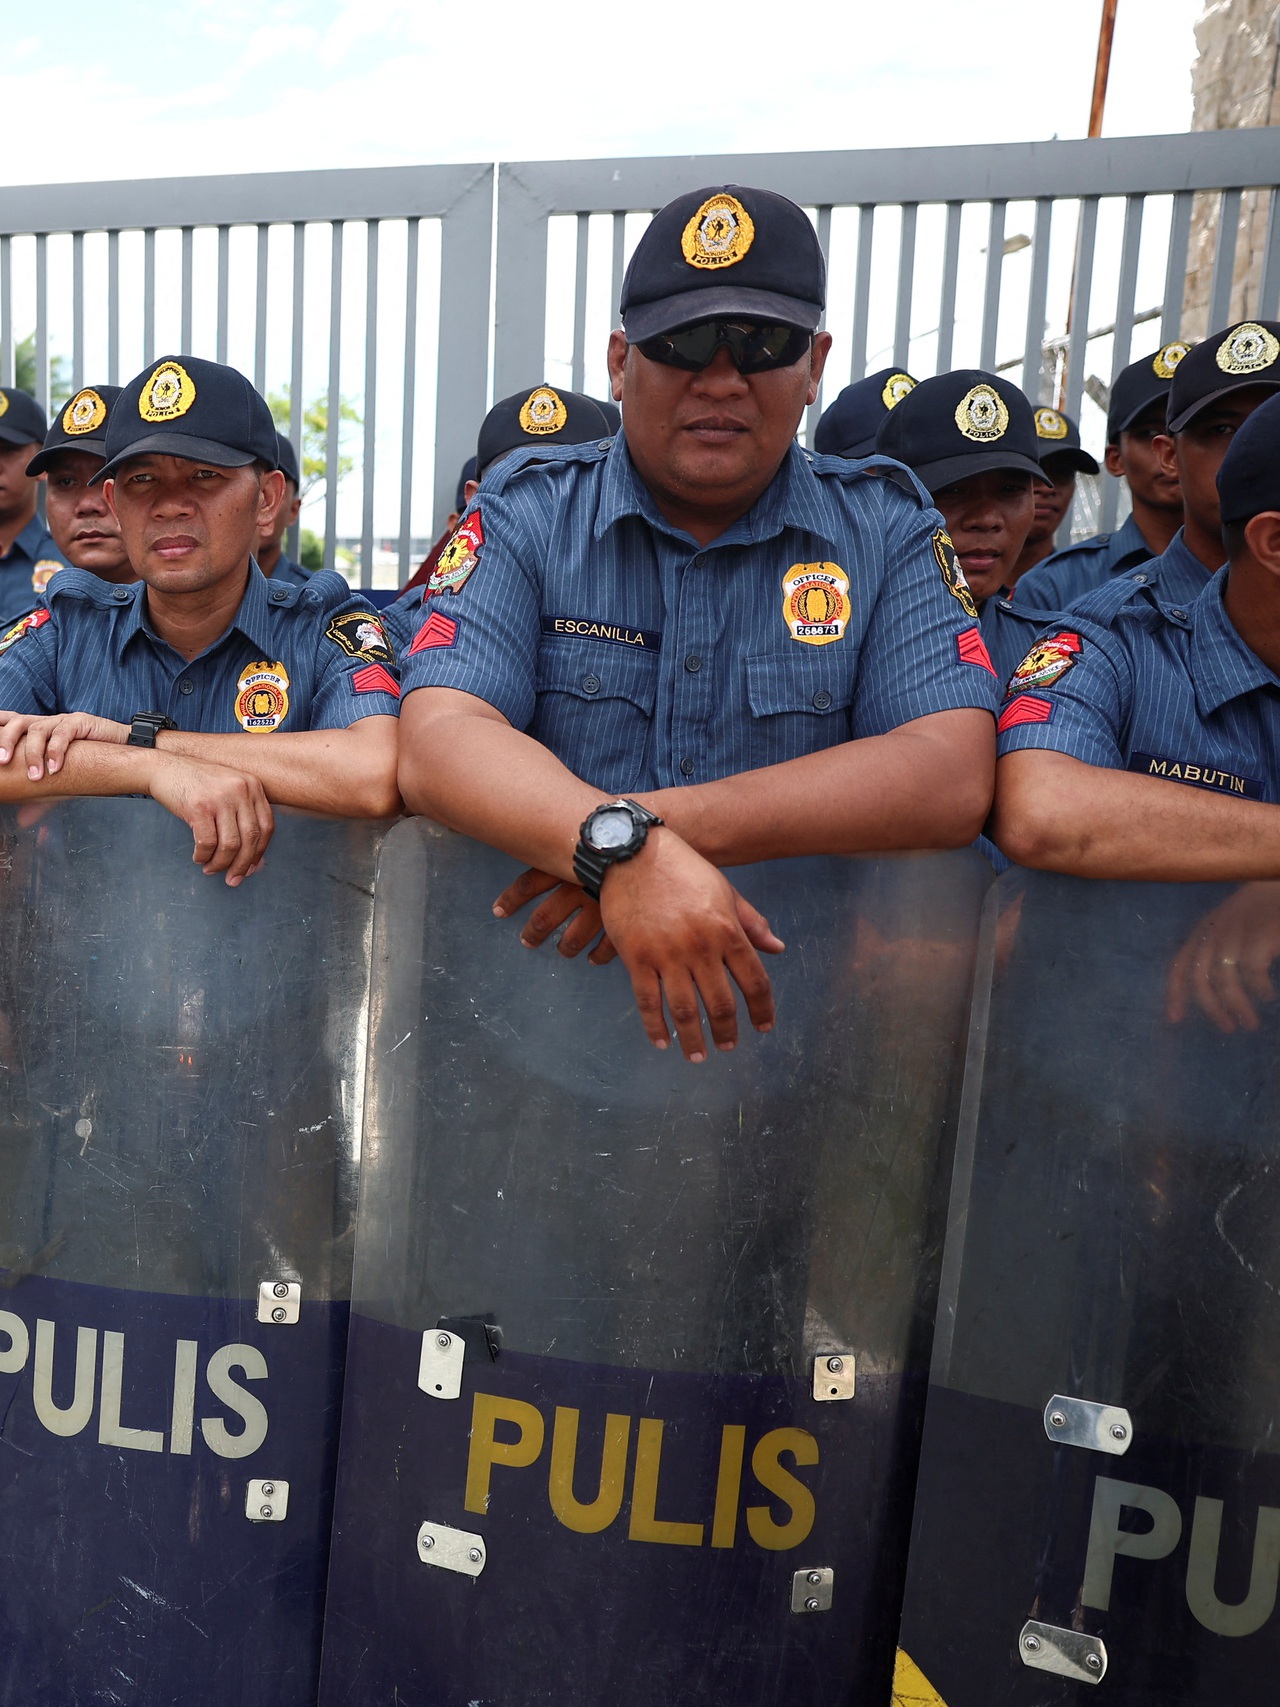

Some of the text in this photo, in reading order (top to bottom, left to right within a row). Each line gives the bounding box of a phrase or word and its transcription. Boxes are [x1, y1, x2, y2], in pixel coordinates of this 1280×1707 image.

[694, 252, 736, 265] POLICE
[969, 428, 1000, 438] POLICE
[793, 574, 837, 586] OFFICER
[554, 619, 645, 646] ESCANILLA
[1148, 759, 1245, 793] MABUTIN
[463, 1392, 820, 1551] PULIS
